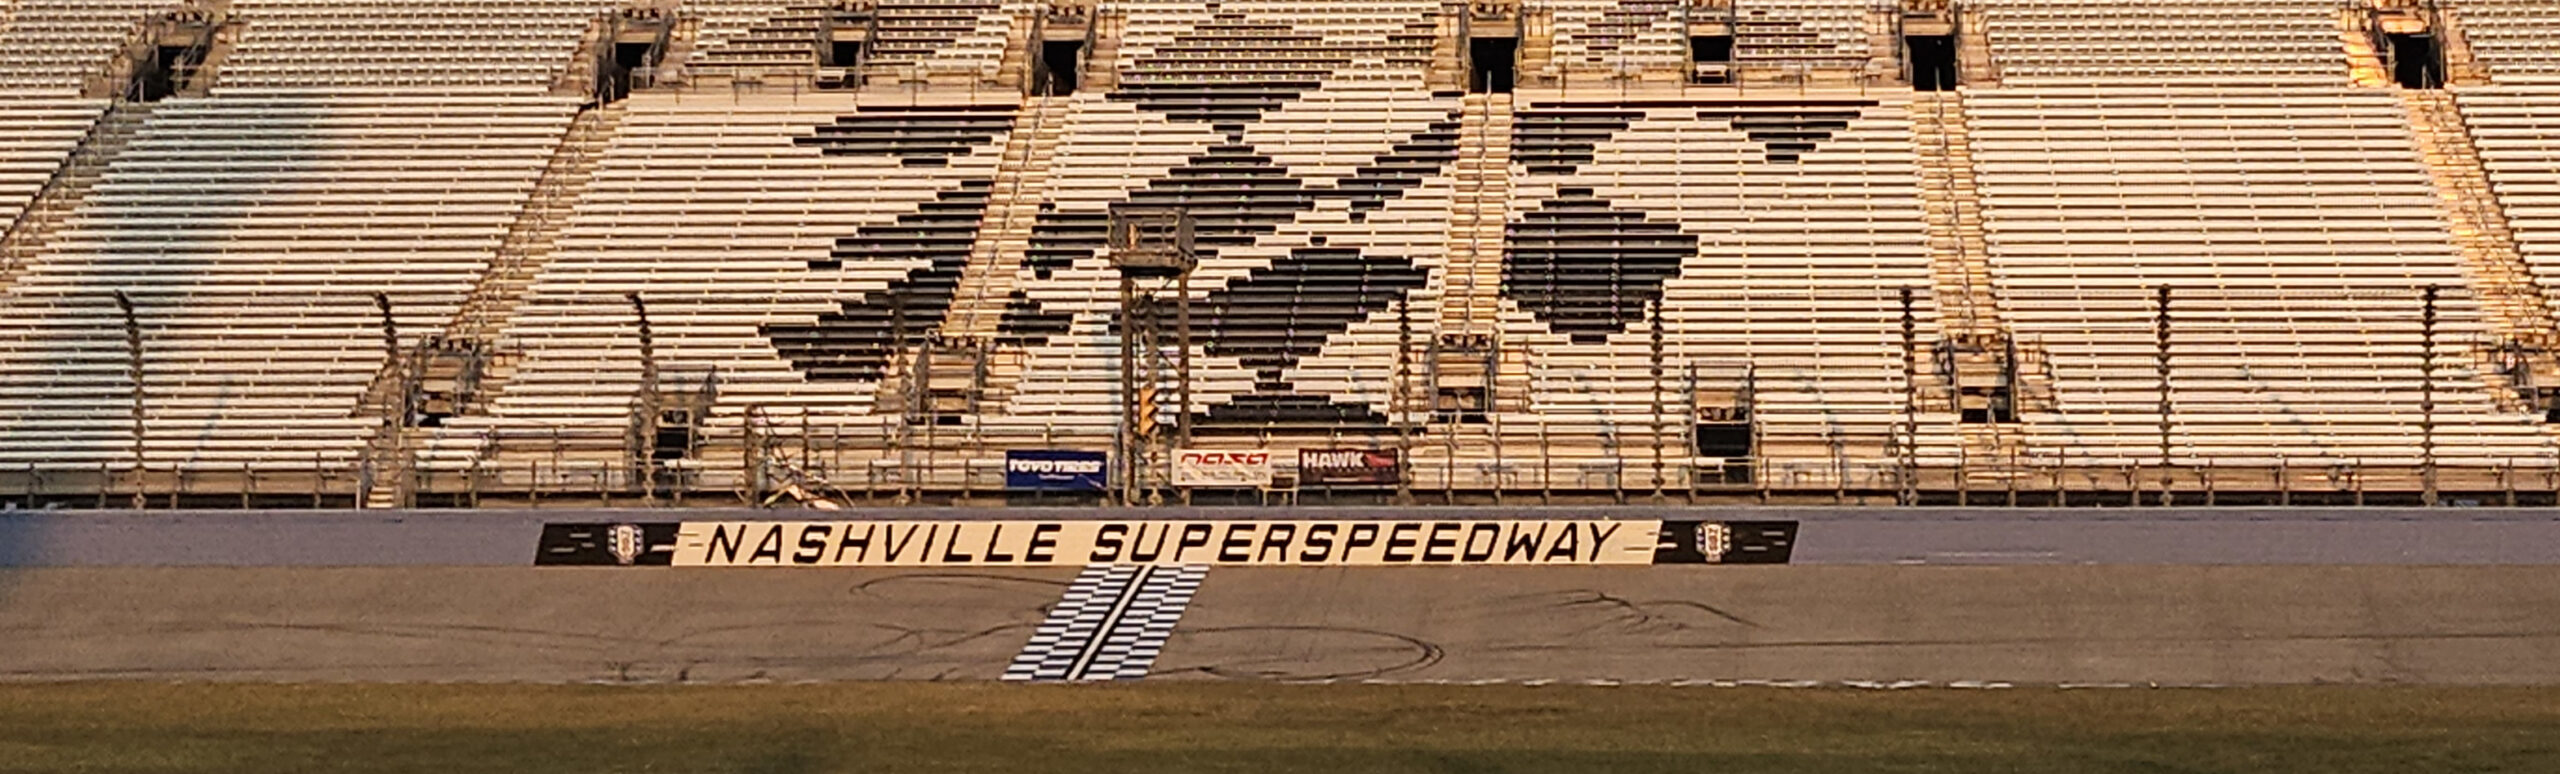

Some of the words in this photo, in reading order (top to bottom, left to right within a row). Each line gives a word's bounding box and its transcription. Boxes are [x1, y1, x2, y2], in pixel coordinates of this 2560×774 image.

[1009, 459, 1053, 472] TOYO
[1302, 451, 1364, 468] HAWK
[705, 523, 1062, 564] NASHVILLE
[1089, 522, 1621, 562] SUPERSPEEDWAY
